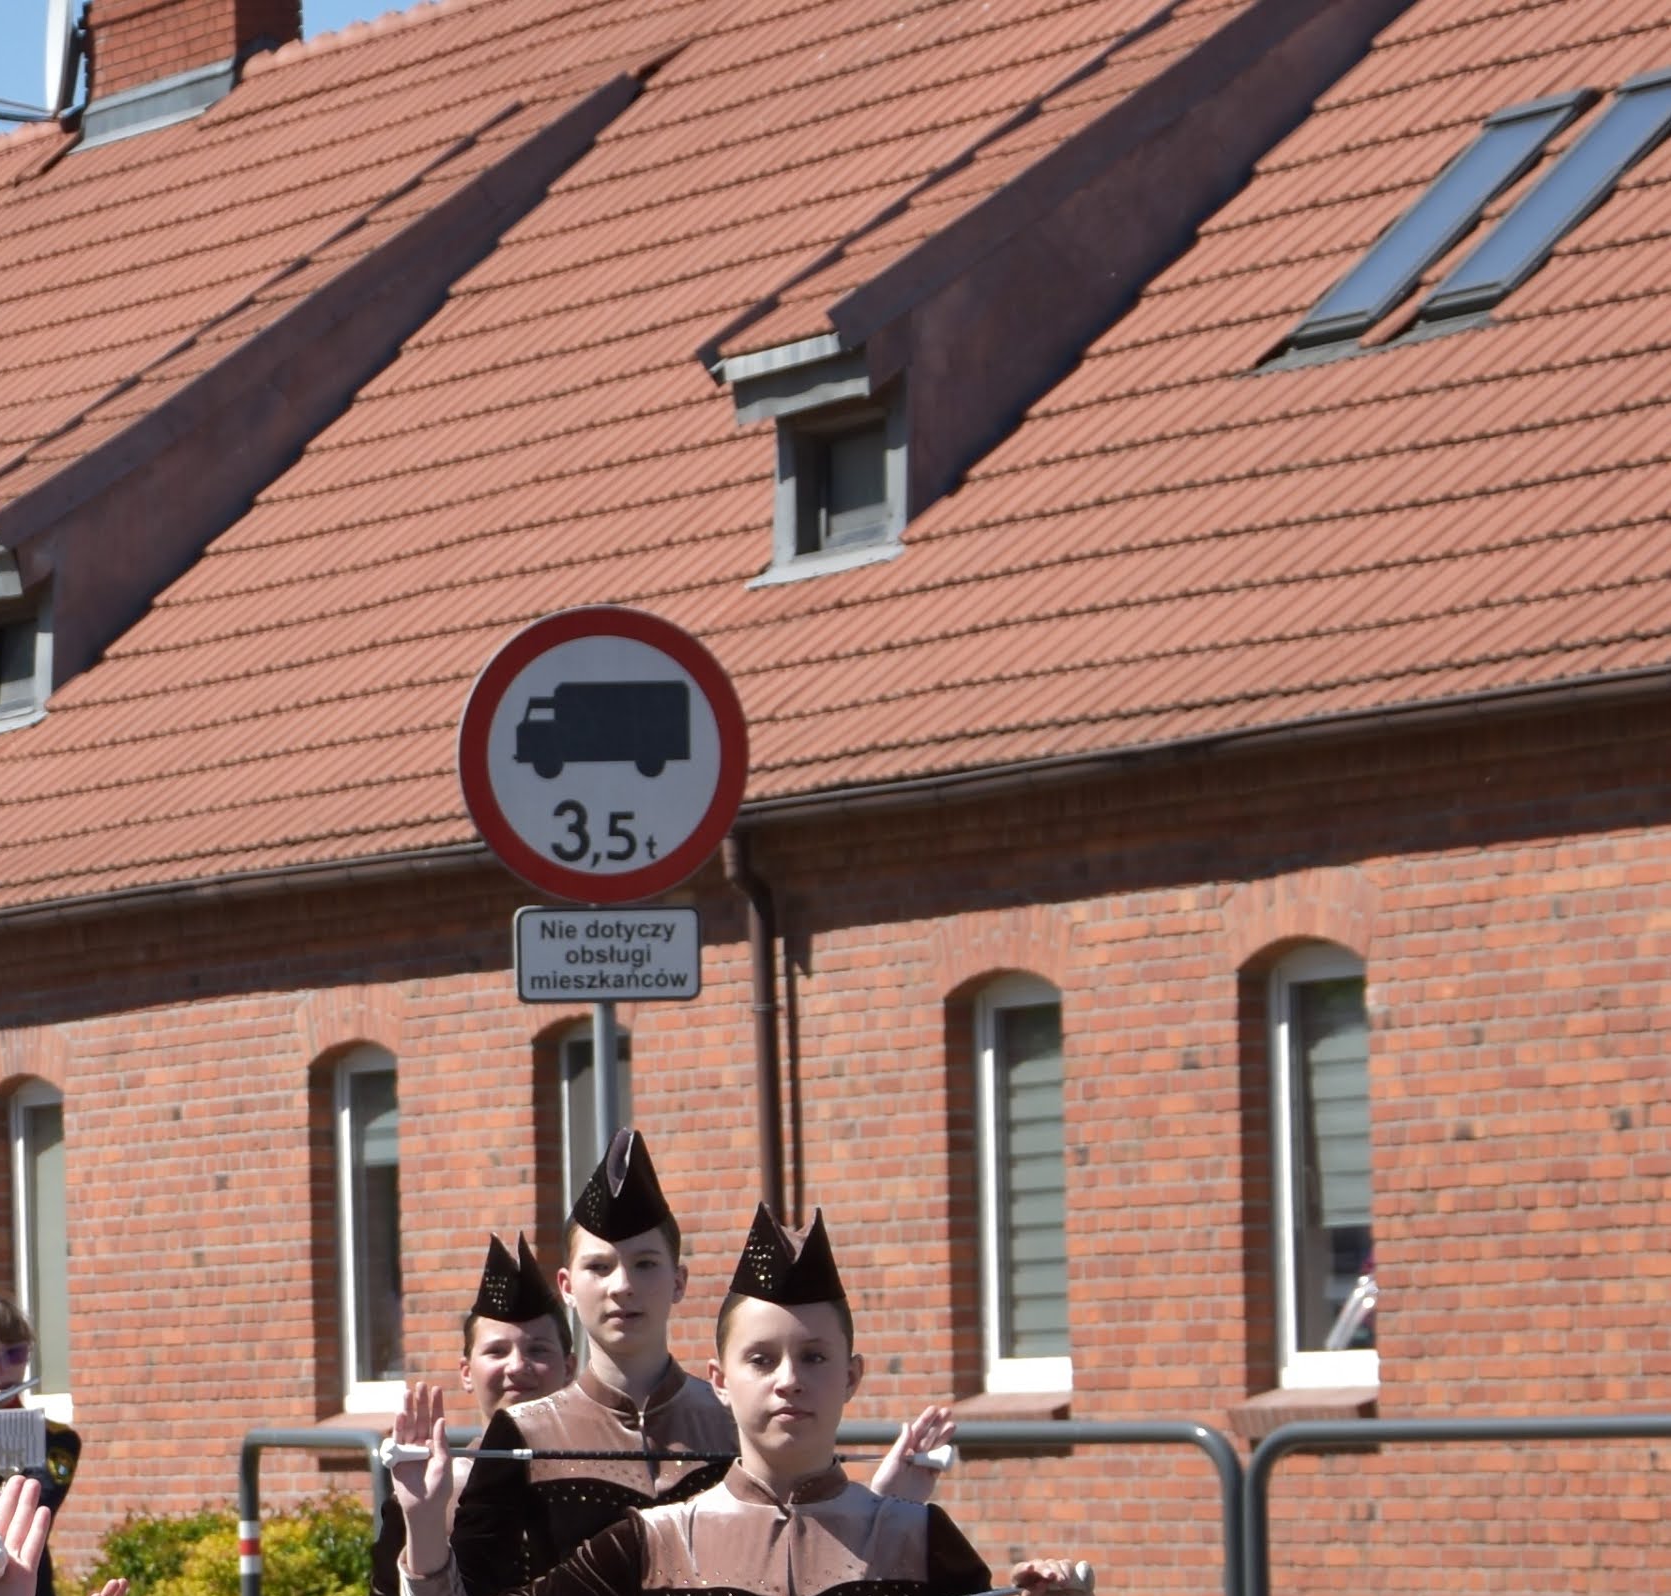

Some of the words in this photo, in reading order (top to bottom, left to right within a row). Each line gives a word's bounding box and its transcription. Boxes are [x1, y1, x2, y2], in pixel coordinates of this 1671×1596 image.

[551, 798, 638, 868] 3,5
[539, 920, 578, 940] Nie
[585, 920, 676, 943] dotyczy
[564, 944, 652, 968] obsługi
[529, 968, 688, 990] mieszkańców
